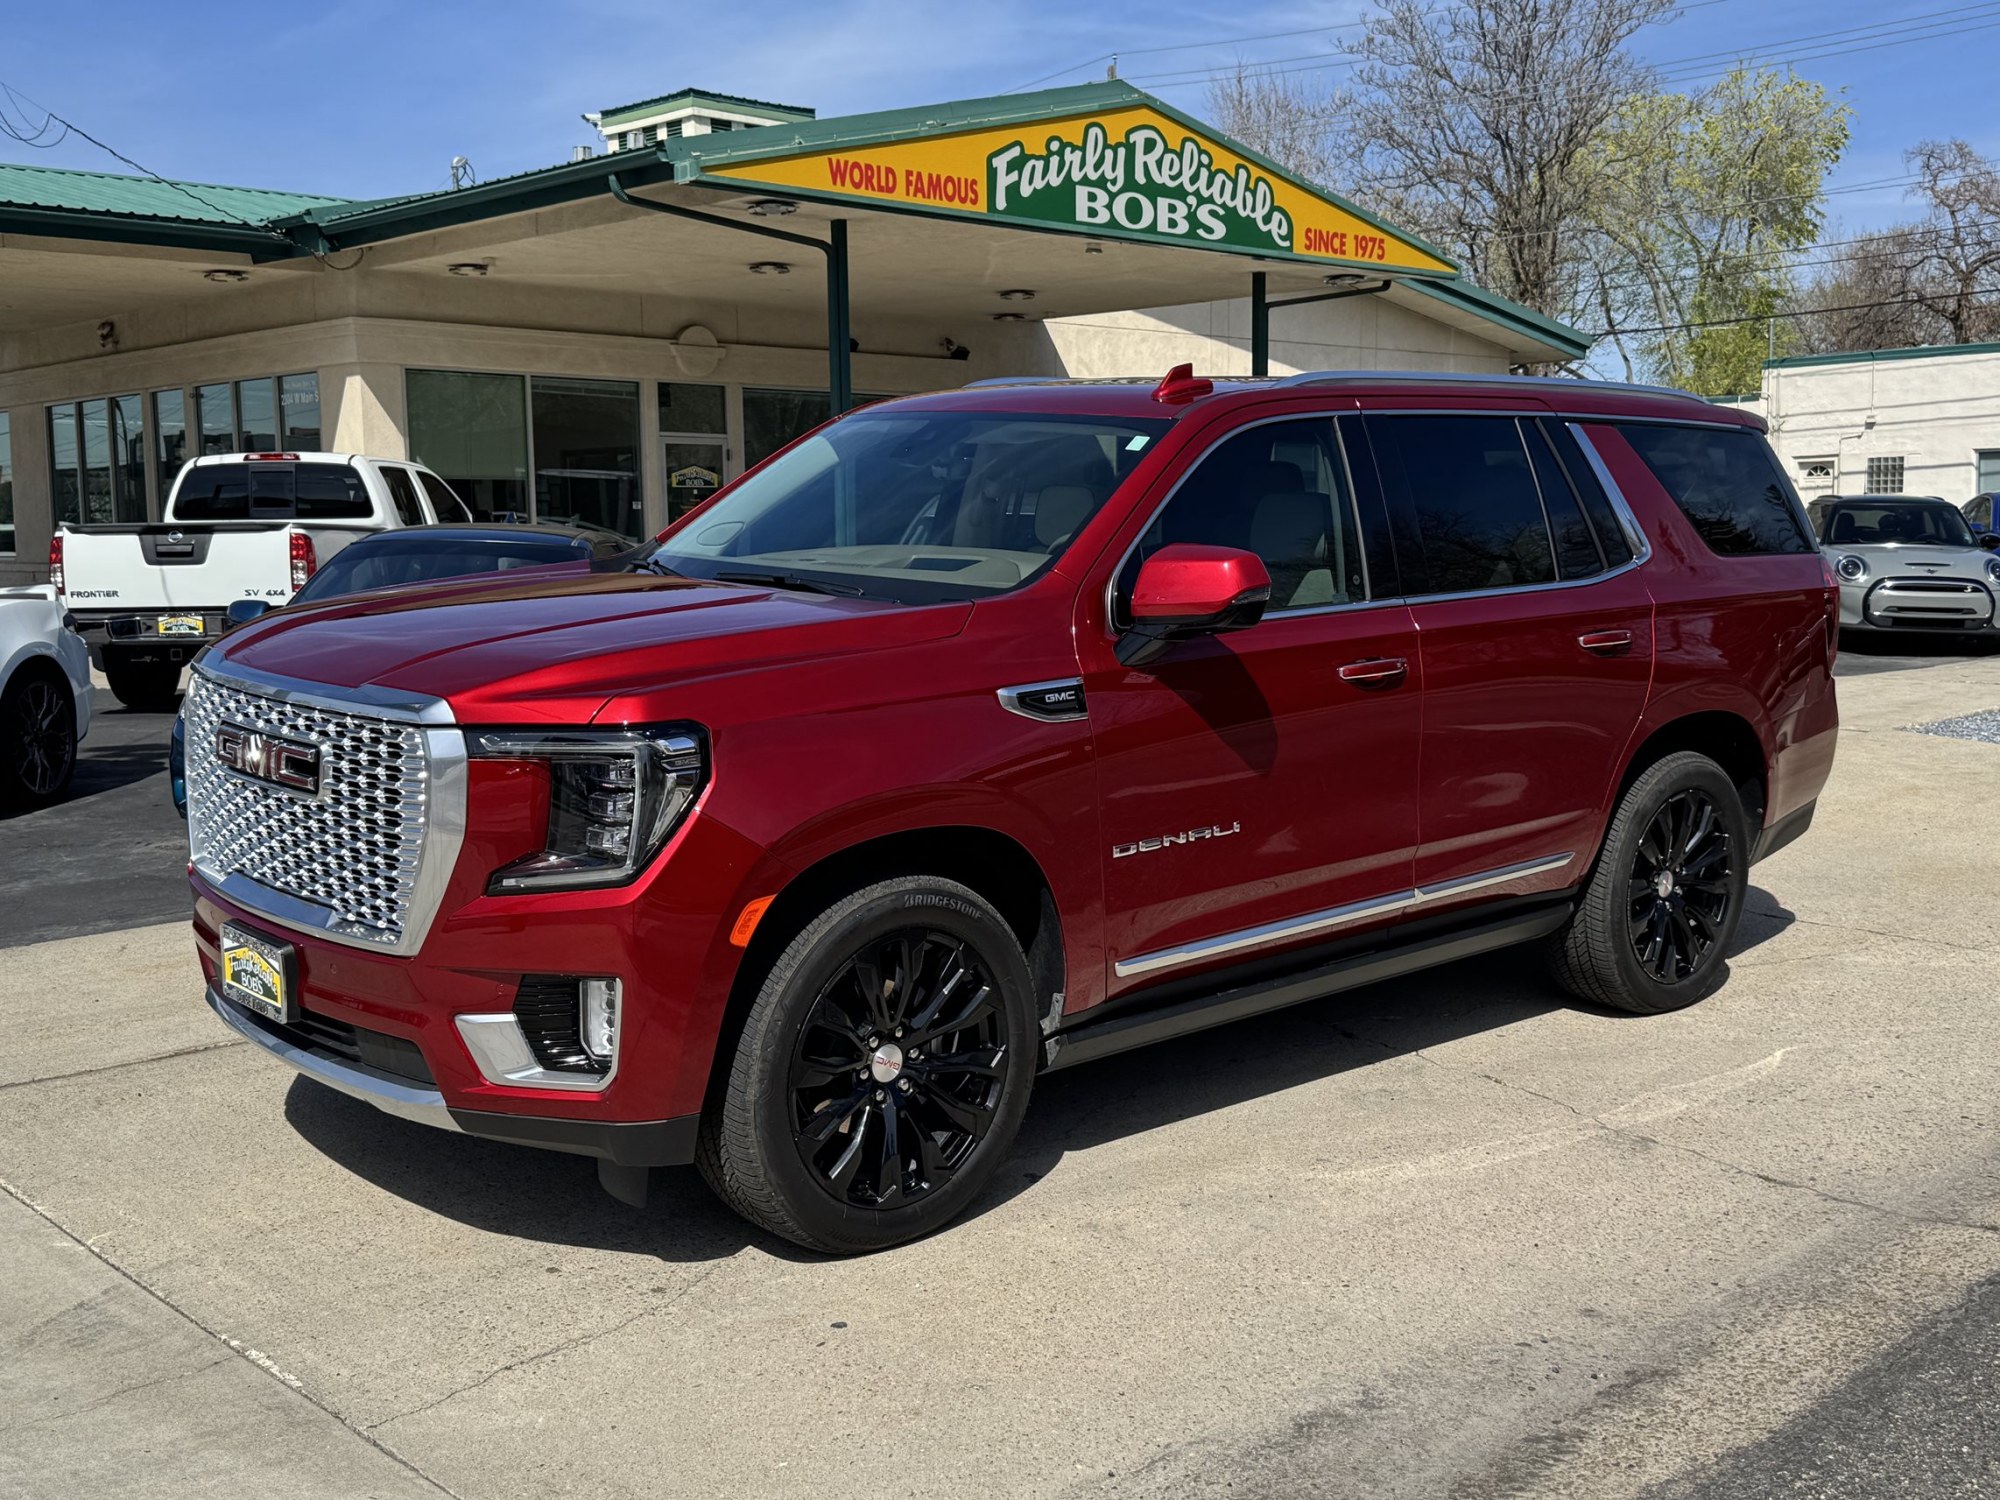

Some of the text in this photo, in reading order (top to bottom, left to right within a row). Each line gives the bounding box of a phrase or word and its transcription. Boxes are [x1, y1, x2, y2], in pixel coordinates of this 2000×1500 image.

[828, 157, 980, 206] WORLD FAMOUS
[991, 125, 1291, 248] Fairly Reliable
[1075, 184, 1228, 241] BOB'S
[1304, 228, 1386, 261] SINCE 1975
[70, 590, 119, 599] FRONTIER
[245, 589, 259, 597] SV
[1045, 690, 1076, 703] GMC
[217, 726, 317, 791] GMC
[1112, 820, 1241, 859] DENALI
[904, 894, 982, 919] BRIDGESTONE
[875, 1056, 901, 1071] GMC
